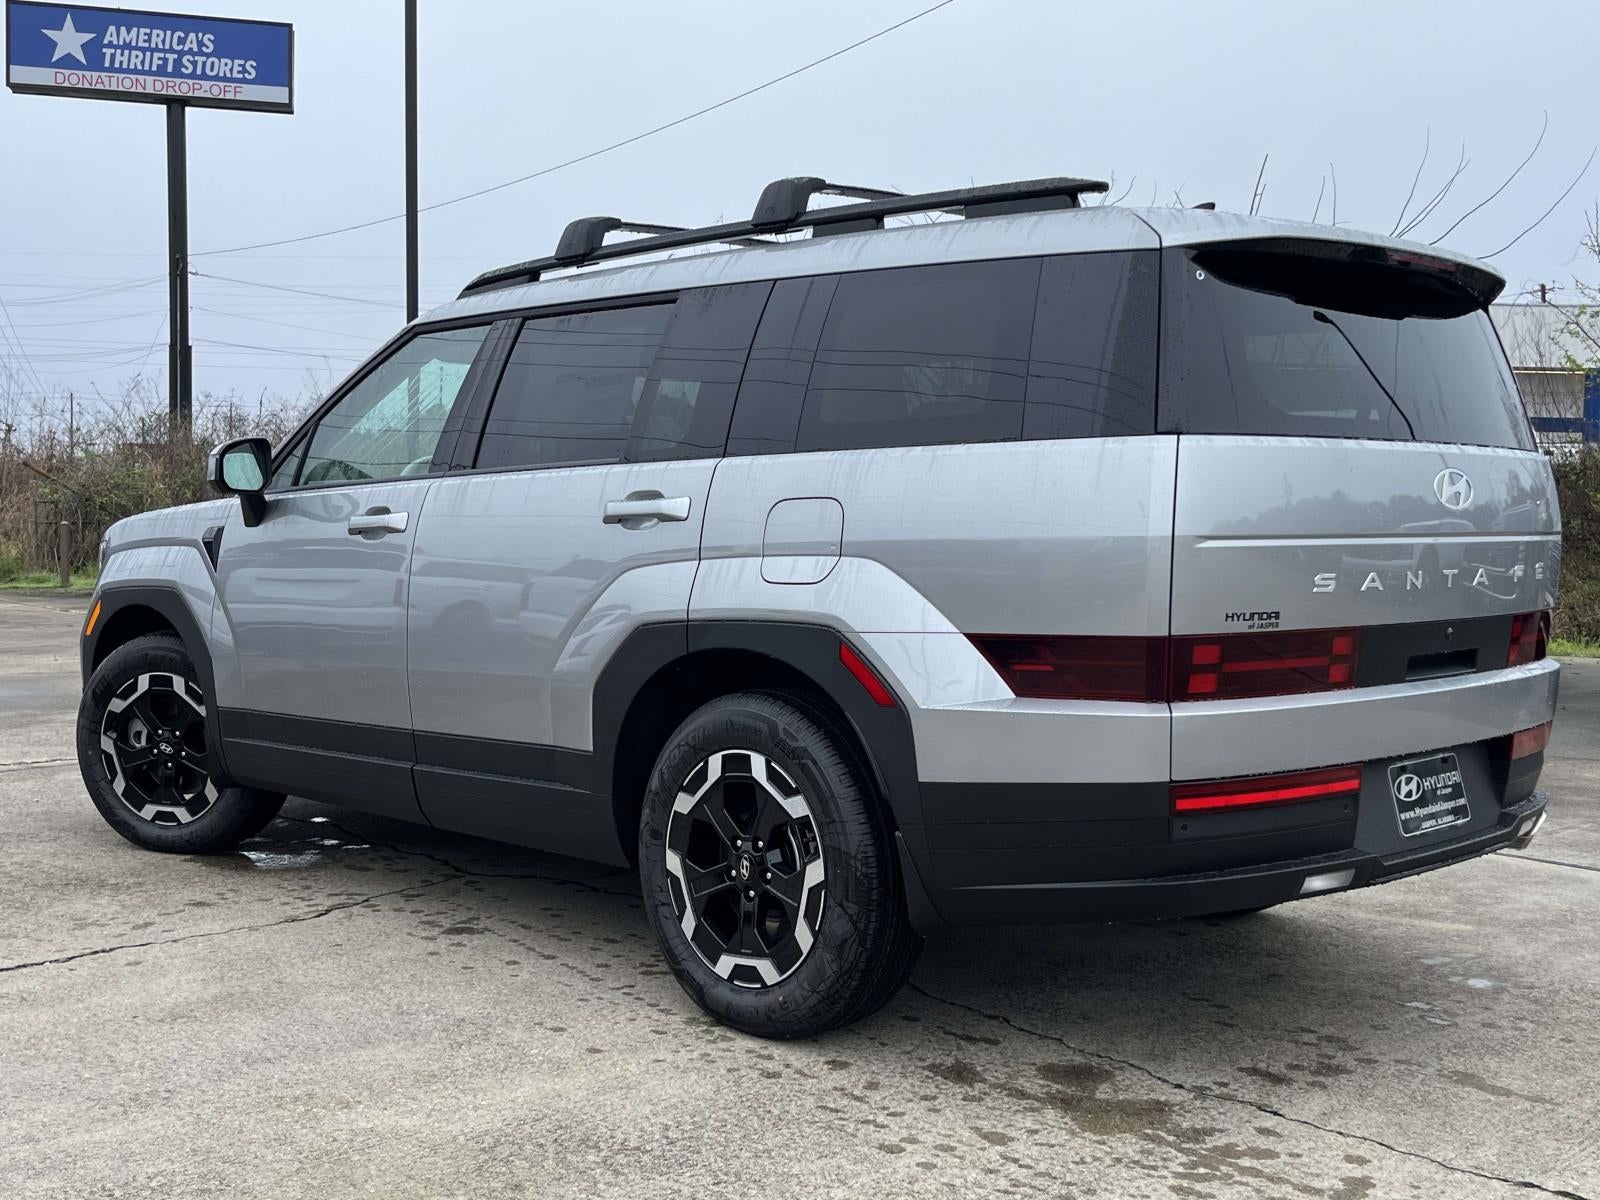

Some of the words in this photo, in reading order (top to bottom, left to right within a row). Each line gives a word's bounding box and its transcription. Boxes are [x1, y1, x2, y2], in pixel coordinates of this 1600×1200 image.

[103, 25, 215, 53] AMERICA'S
[102, 48, 178, 73] THRIFT
[181, 54, 257, 80] STORES
[54, 71, 147, 91] DONATION
[152, 79, 244, 98] DROP-OFF
[1312, 568, 1489, 593] SANTA
[1512, 562, 1544, 583] FE
[1225, 611, 1280, 622] HYUNDAI
[1422, 770, 1460, 790] HYUNDAI
